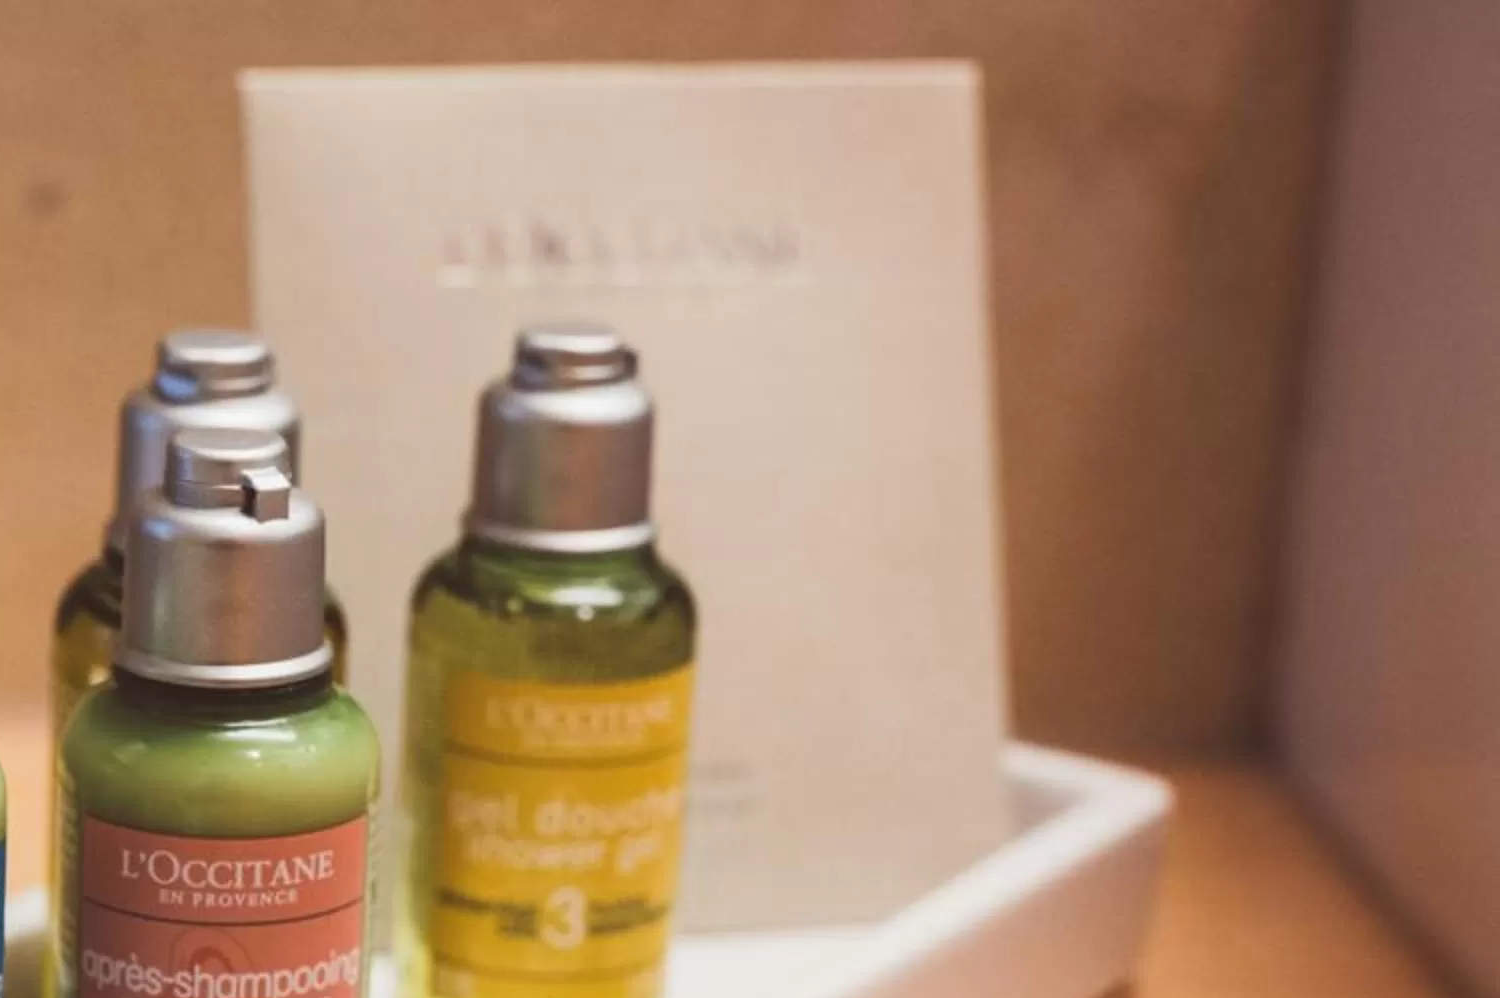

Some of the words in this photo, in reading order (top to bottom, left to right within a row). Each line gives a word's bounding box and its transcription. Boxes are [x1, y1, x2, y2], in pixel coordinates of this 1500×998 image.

[121, 849, 336, 890] L'OCCITANE
[158, 888, 184, 905] EN
[192, 889, 299, 909] PROVENCE
[540, 886, 589, 947] 3
